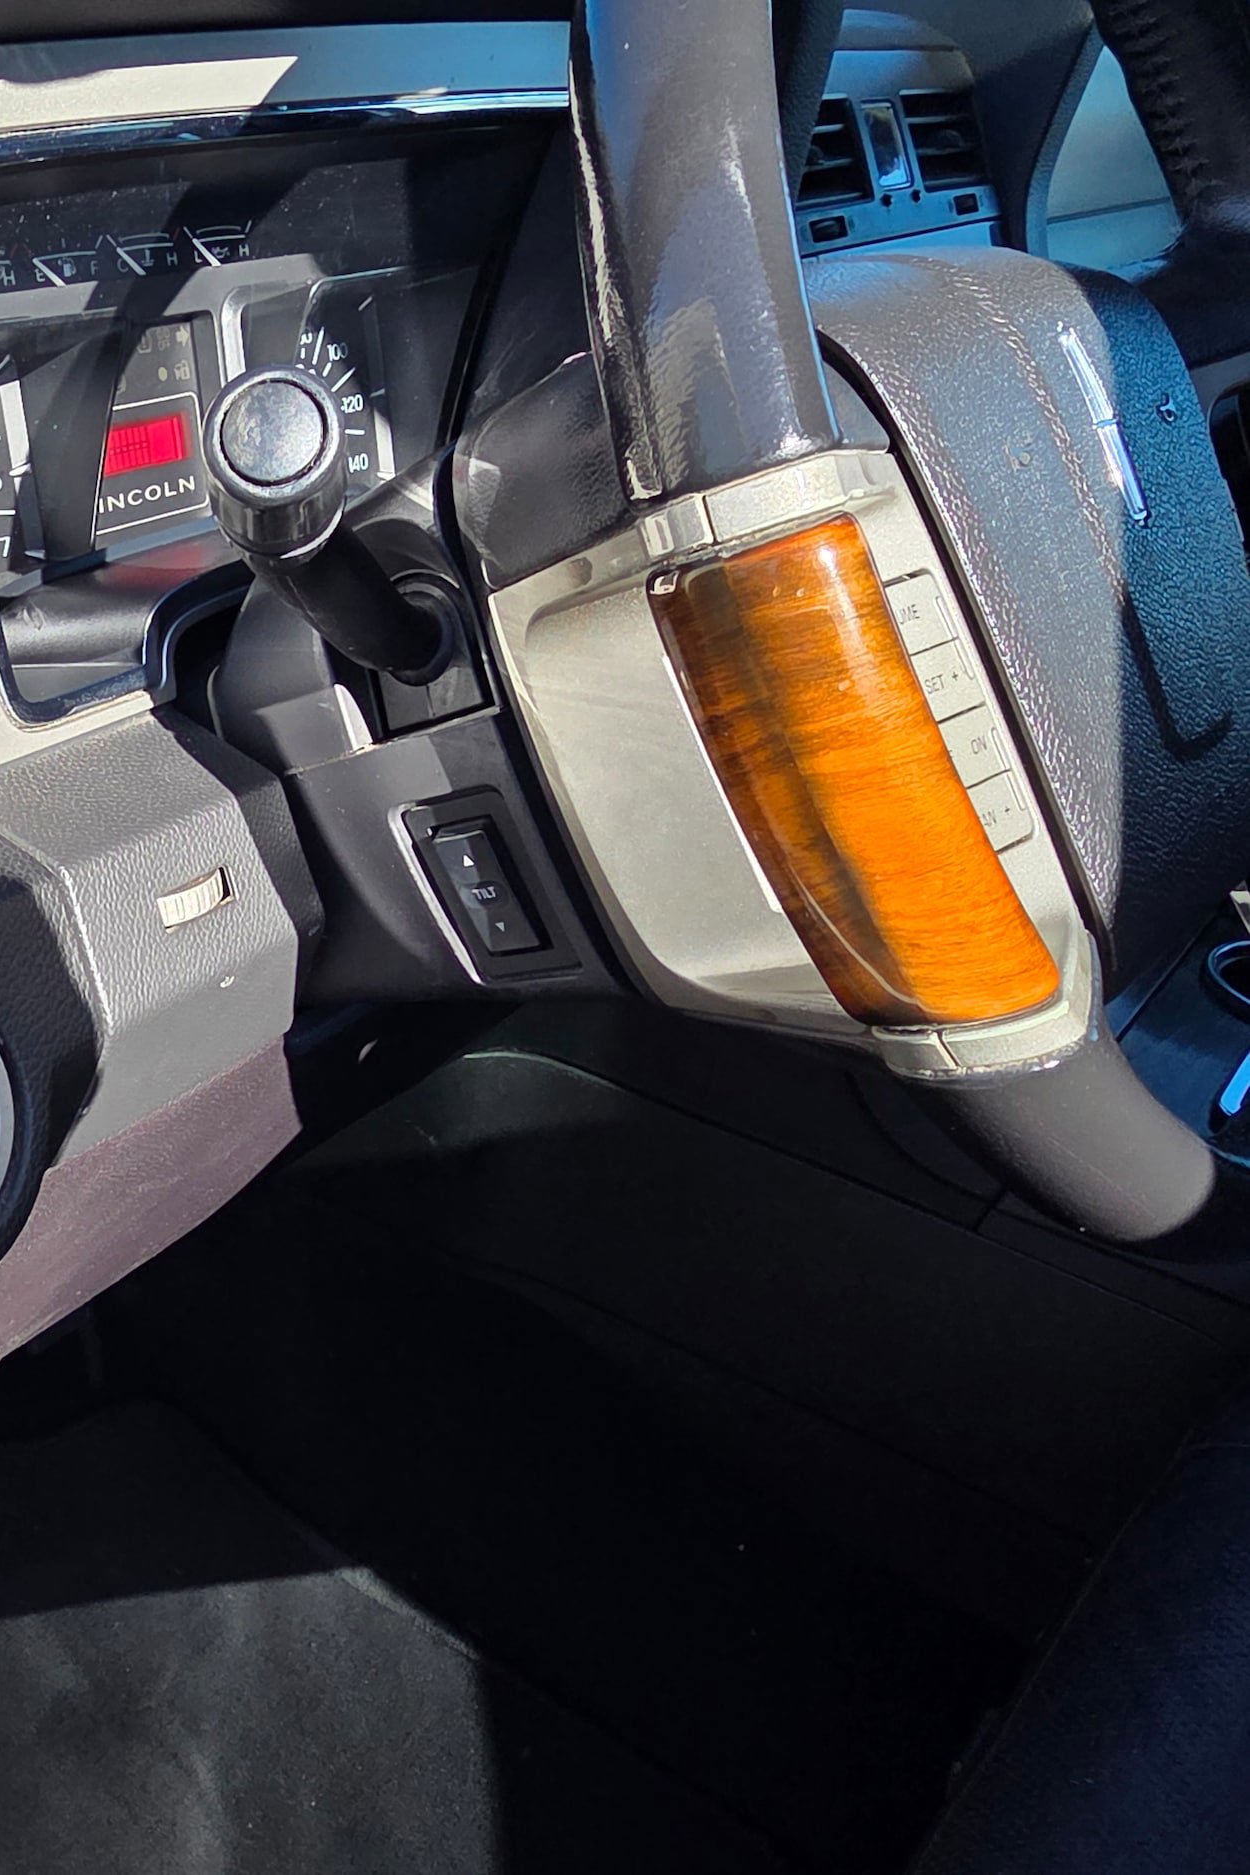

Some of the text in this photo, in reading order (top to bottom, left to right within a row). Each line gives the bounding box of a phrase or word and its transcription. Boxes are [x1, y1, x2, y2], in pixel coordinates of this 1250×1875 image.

[166, 251, 178, 266] H
[239, 244, 250, 257] H
[90, 261, 99, 275] F
[3, 270, 16, 286] H
[327, 343, 348, 362] 100
[342, 394, 363, 414] 120
[348, 453, 369, 473] 140
[98, 475, 196, 514] INCOLN
[0, 536, 11, 557] 7
[896, 604, 920, 625] UME
[924, 674, 945, 694] SET
[970, 735, 988, 755] ON
[980, 809, 997, 827] AN
[471, 886, 497, 900] TILT
